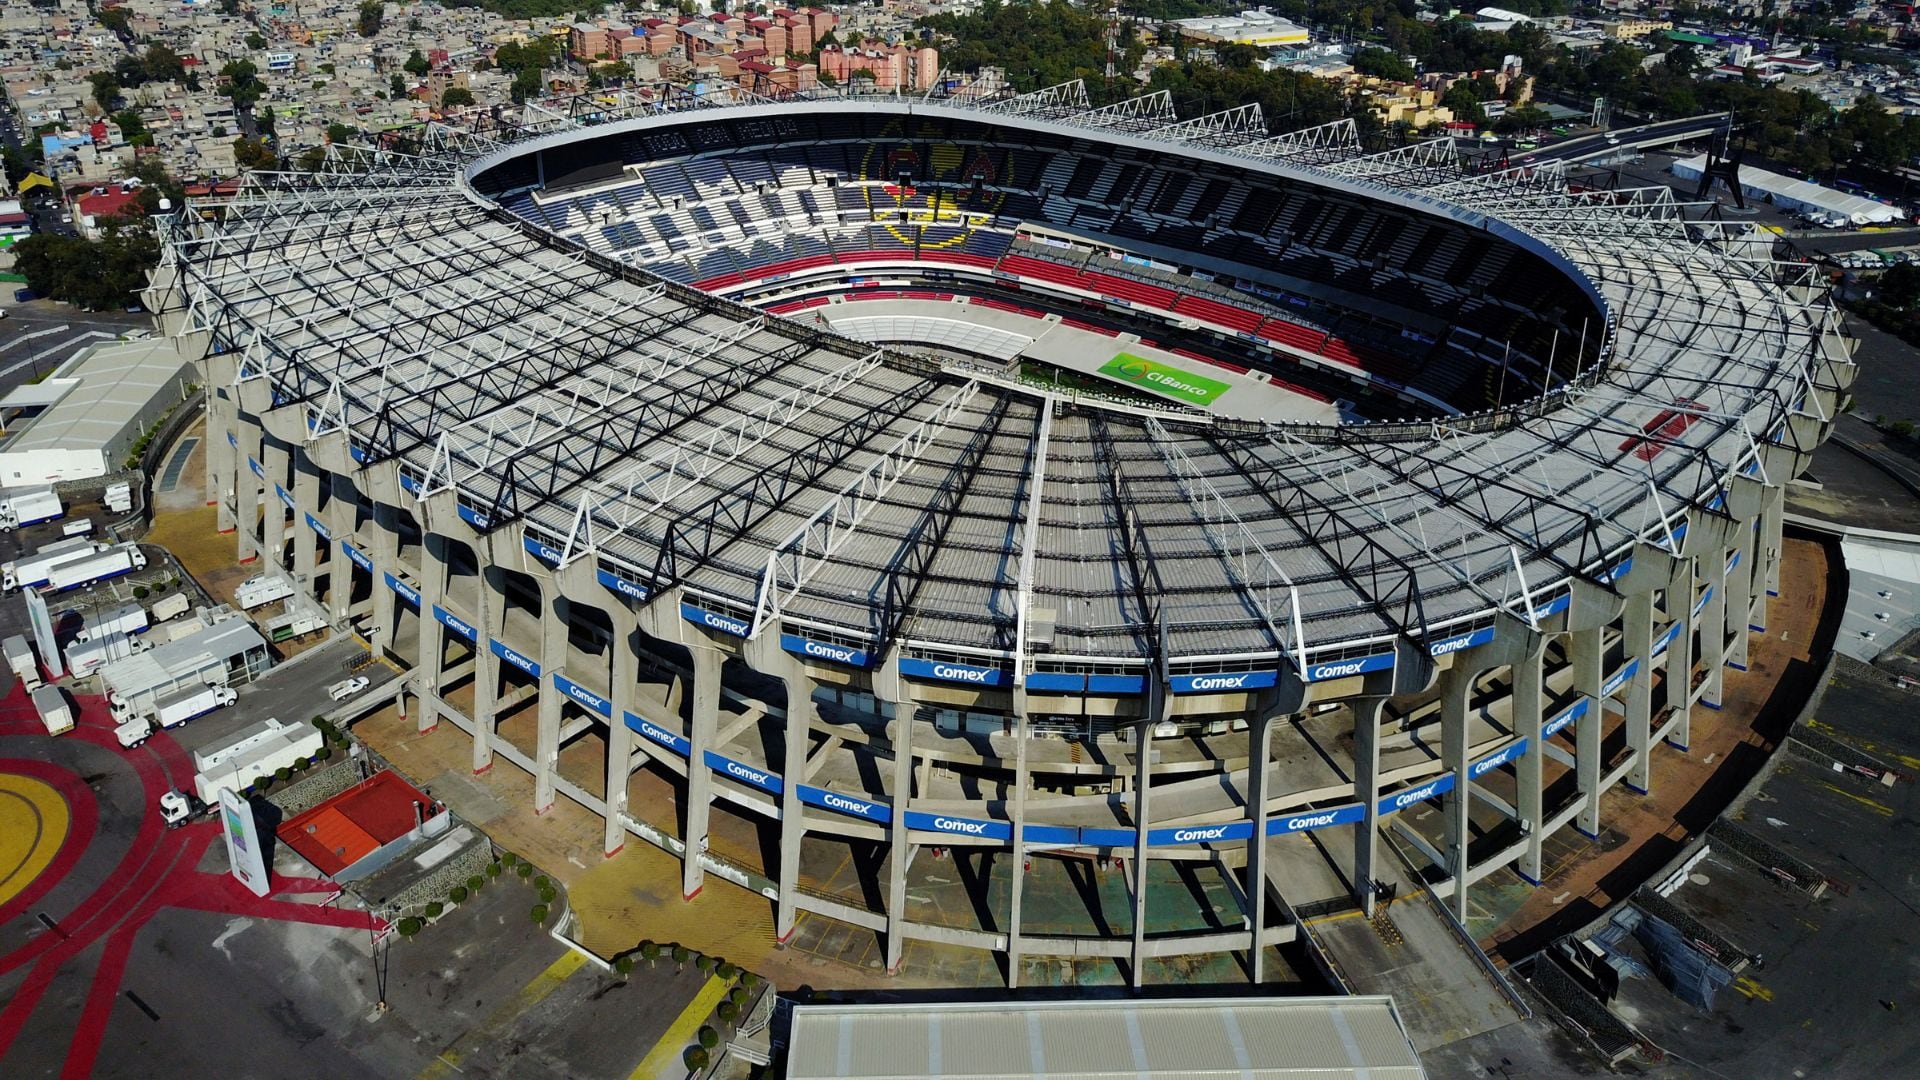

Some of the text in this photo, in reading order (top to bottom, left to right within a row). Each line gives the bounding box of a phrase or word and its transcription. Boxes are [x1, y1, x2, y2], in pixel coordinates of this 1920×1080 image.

[395, 582, 417, 602] Comex
[617, 580, 647, 600] Come
[446, 615, 471, 636] Comex
[705, 612, 749, 637] Comex
[805, 641, 857, 663] Comex
[1430, 633, 1475, 656] Comex
[504, 649, 534, 671] Comex
[1315, 659, 1368, 679] Comex
[934, 664, 990, 682] Comex
[1191, 674, 1248, 690] Comex
[570, 685, 603, 709] Comex
[1546, 710, 1574, 734] Comex
[641, 722, 677, 745] Comex
[1475, 750, 1510, 774] Comex
[727, 762, 769, 785] Comex
[824, 794, 872, 815] Comex
[1396, 783, 1437, 806] Comex
[934, 817, 988, 834] Comex
[1288, 811, 1338, 831] Comex
[1174, 825, 1228, 842] Comex
